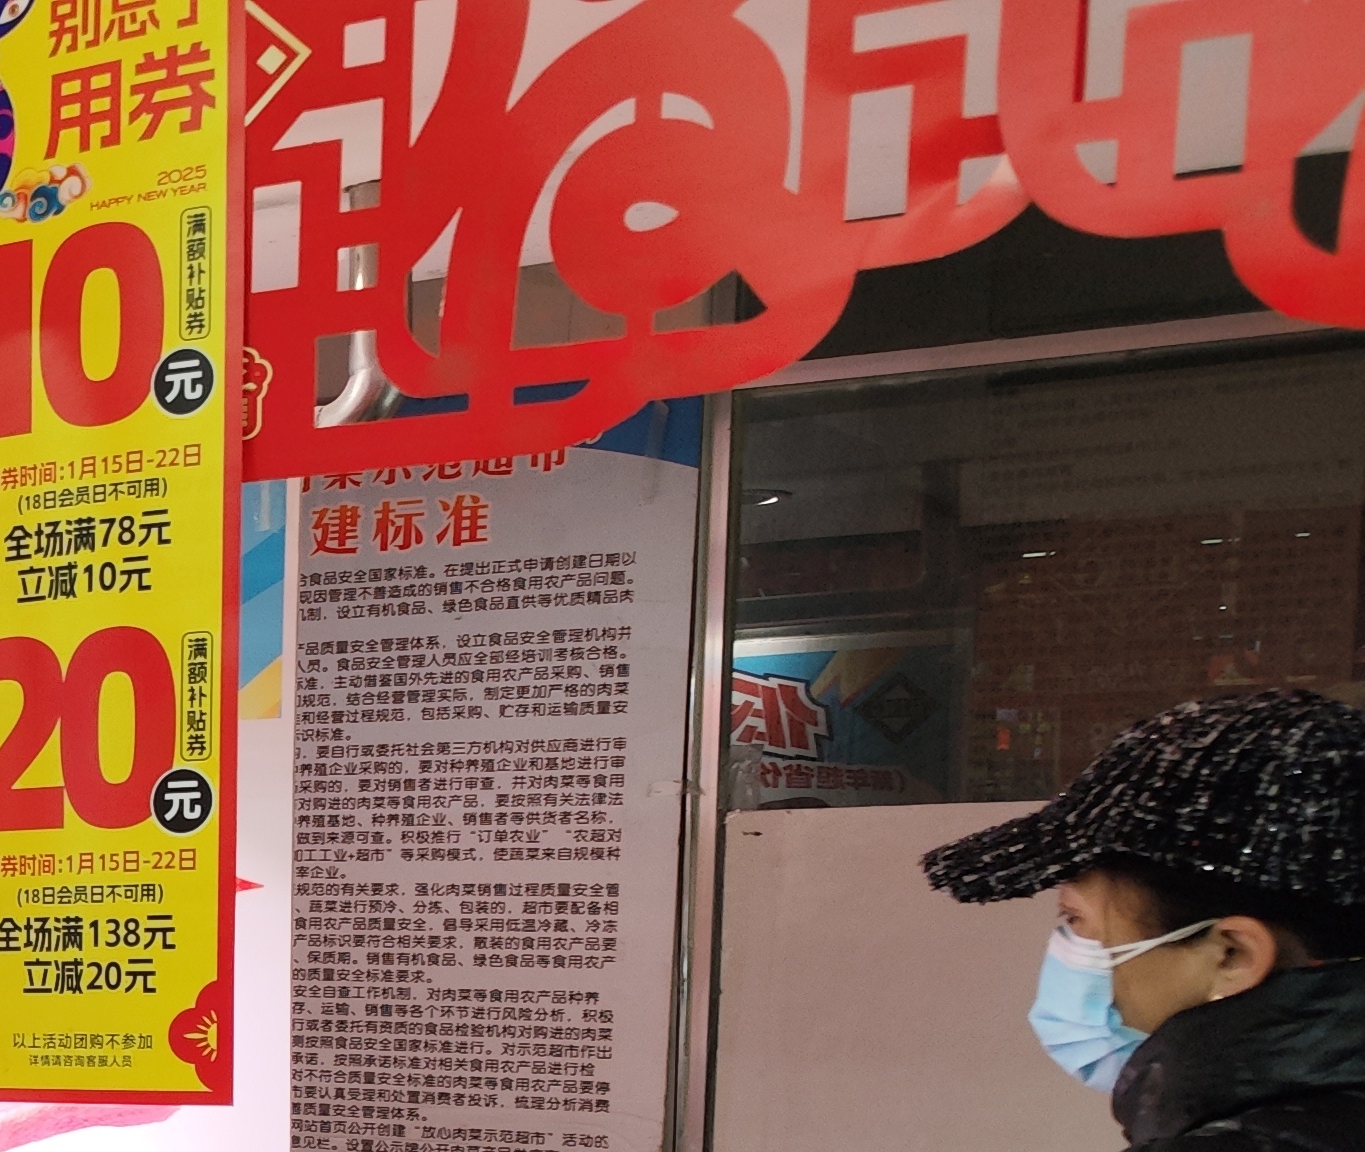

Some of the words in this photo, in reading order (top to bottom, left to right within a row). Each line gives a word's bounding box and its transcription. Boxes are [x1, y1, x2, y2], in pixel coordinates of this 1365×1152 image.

[43, 40, 216, 160] 用券
[156, 164, 208, 185] 2025
[89, 194, 135, 212] HAPPY
[137, 188, 169, 205] NEW
[170, 182, 208, 199] YEAR
[185, 213, 208, 335] 满额补贴券
[164, 361, 204, 403] 元
[17, 477, 169, 515] (18日会员日不可用)
[3, 509, 172, 563] 全场满78元
[310, 495, 491, 557] 建标准
[16, 555, 153, 604] 立减10元
[186, 637, 209, 756] 满额补贴券
[163, 780, 202, 823] 元
[16, 882, 165, 907] (18日会员日不可用)
[22, 957, 157, 995] 立减20元
[11, 1032, 154, 1051] 以上活动团购不参加
